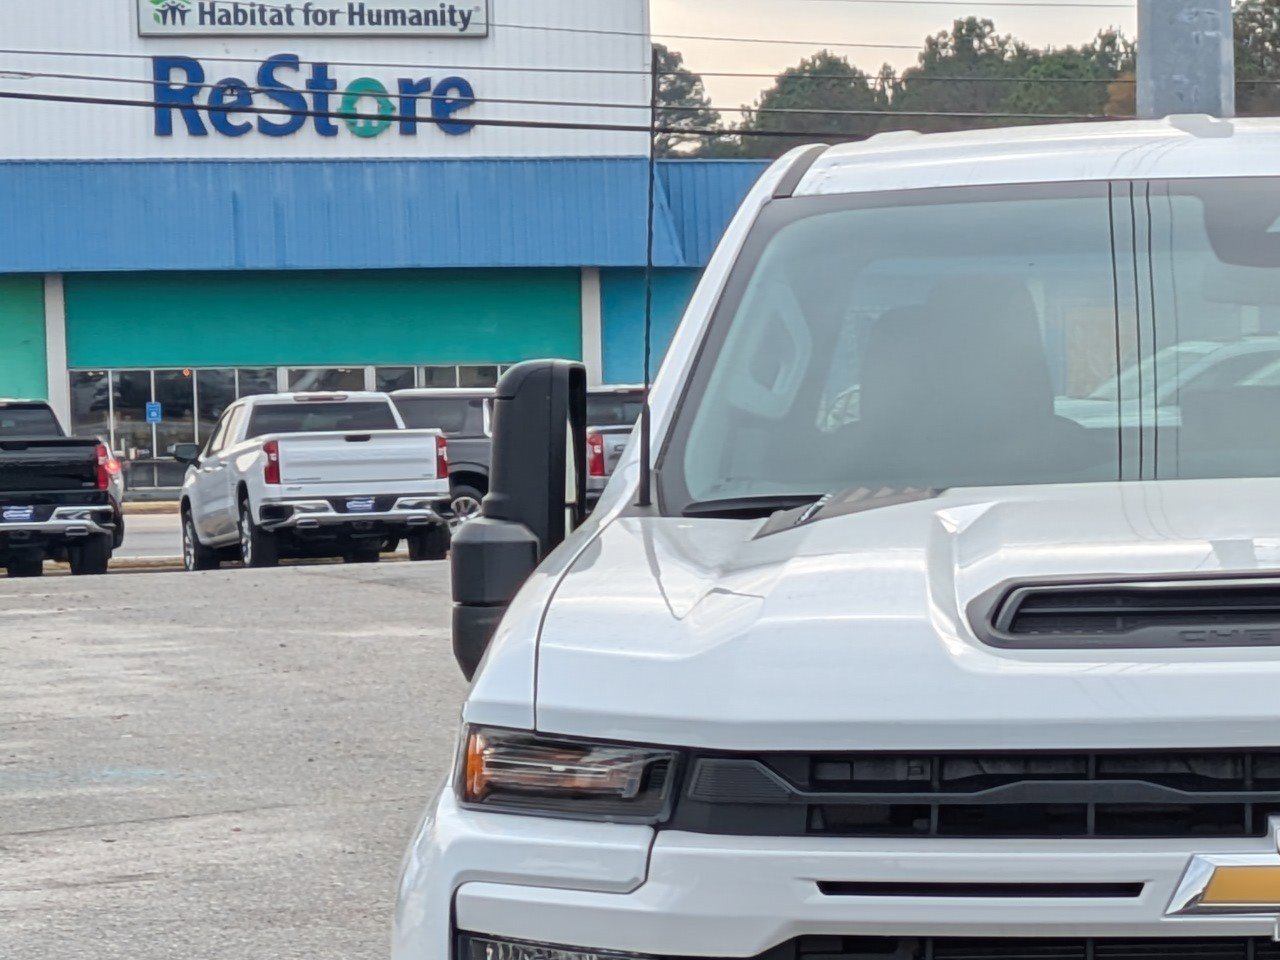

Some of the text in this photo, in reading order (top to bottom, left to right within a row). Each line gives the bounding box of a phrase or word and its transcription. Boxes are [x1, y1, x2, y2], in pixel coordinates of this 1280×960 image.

[200, 1, 473, 32] Habitat for Humanity
[152, 53, 476, 138] ReStore
